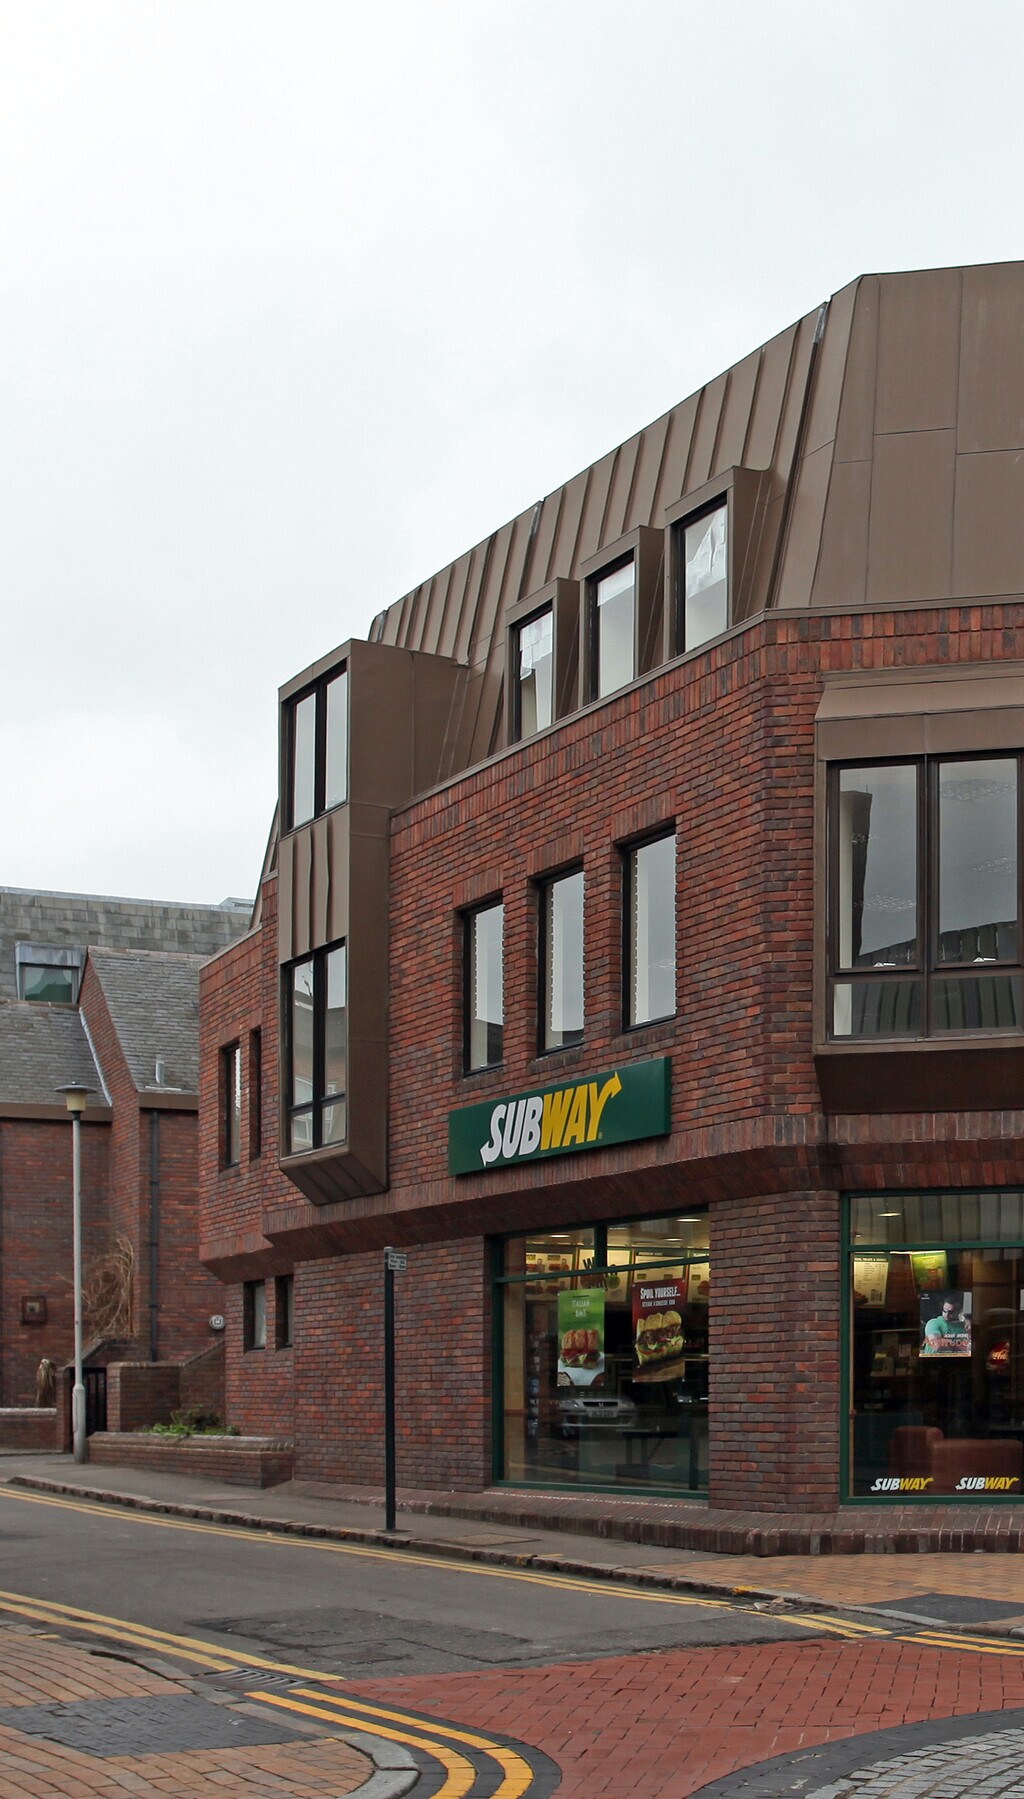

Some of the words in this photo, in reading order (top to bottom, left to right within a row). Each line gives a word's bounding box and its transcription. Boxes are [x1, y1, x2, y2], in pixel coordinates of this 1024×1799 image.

[479, 1071, 623, 1167] SUBWAY
[640, 1287, 654, 1300] SPOIL
[870, 1476, 934, 1492] SUBWAY
[955, 1476, 1020, 1490] SUBWAY
